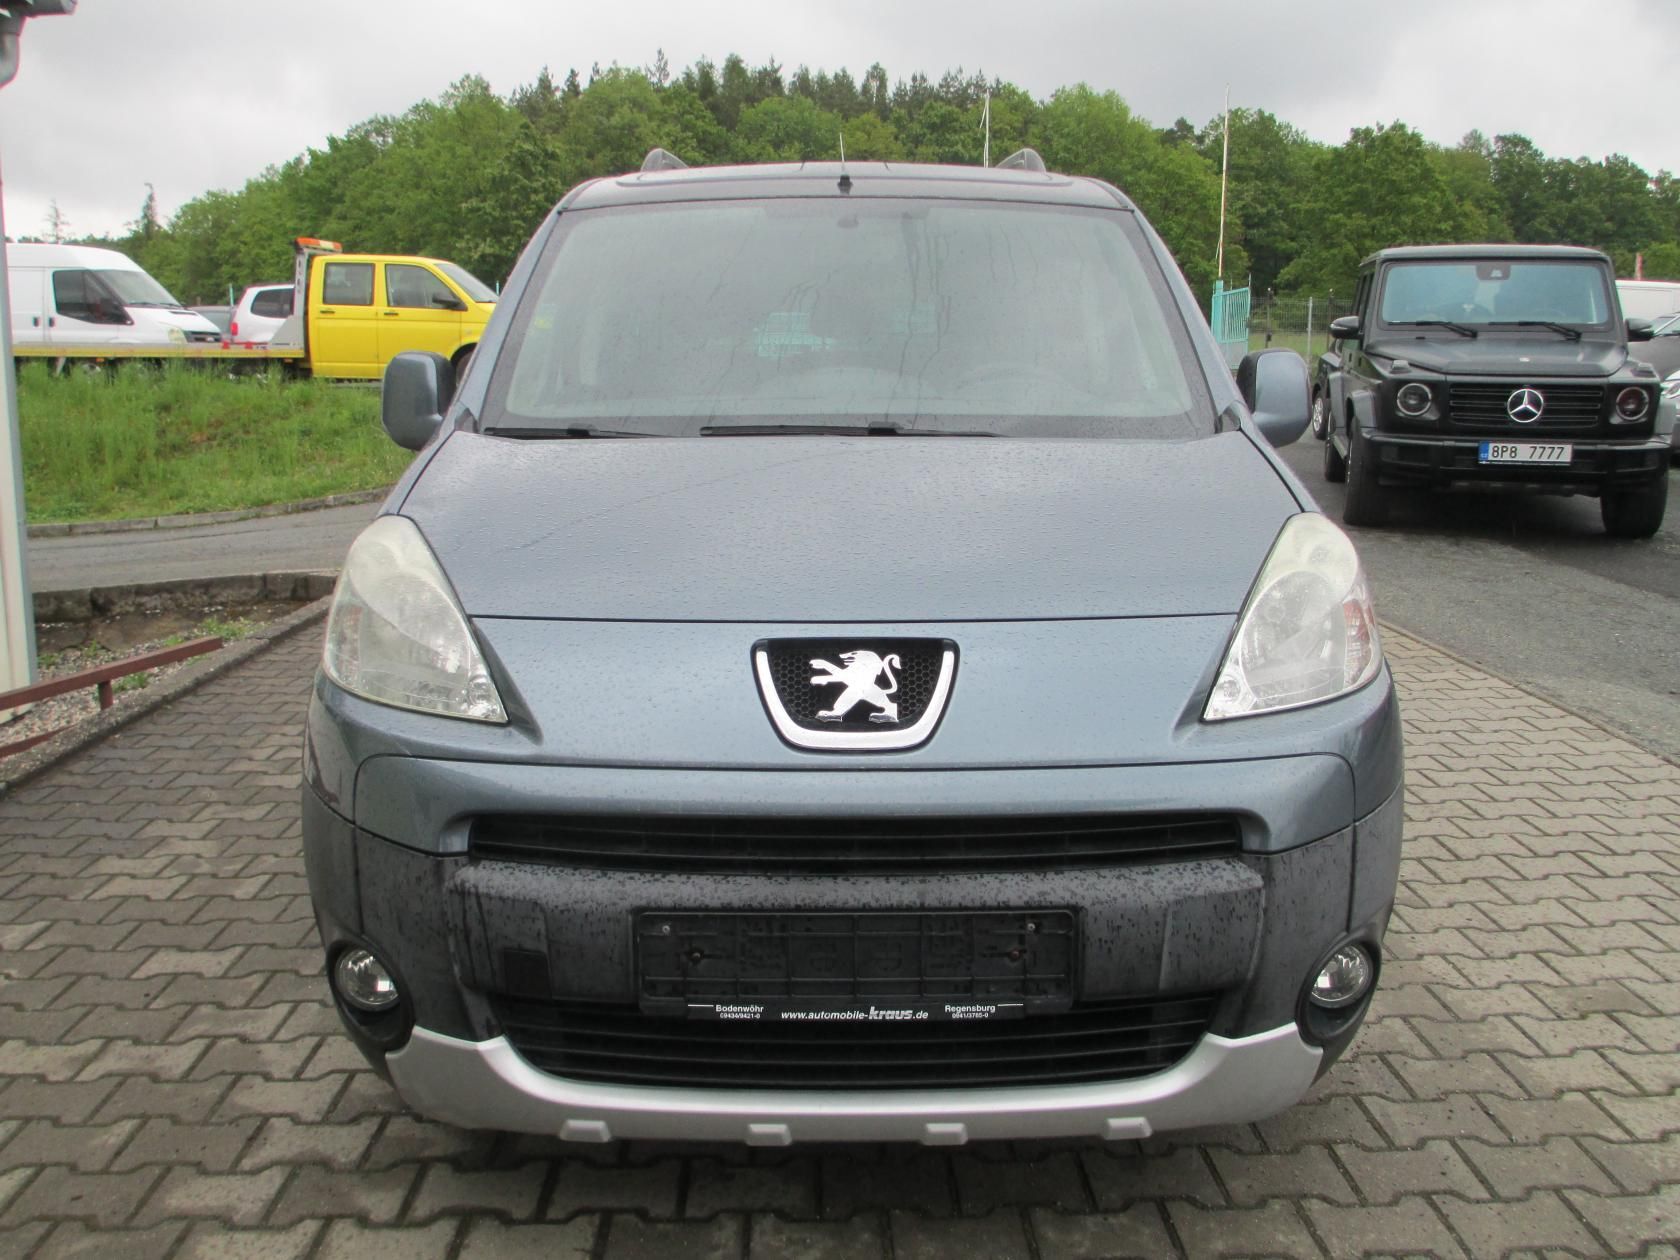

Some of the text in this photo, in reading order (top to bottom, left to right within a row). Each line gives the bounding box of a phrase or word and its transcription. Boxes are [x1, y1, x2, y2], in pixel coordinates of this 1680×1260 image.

[1491, 445, 1518, 459] 8P8
[1529, 446, 1565, 460] 7777
[715, 1004, 764, 1013] Bodenwöhr
[781, 1006, 929, 1020] www.automobile-kraus.de
[944, 1004, 996, 1014] Regensburg
